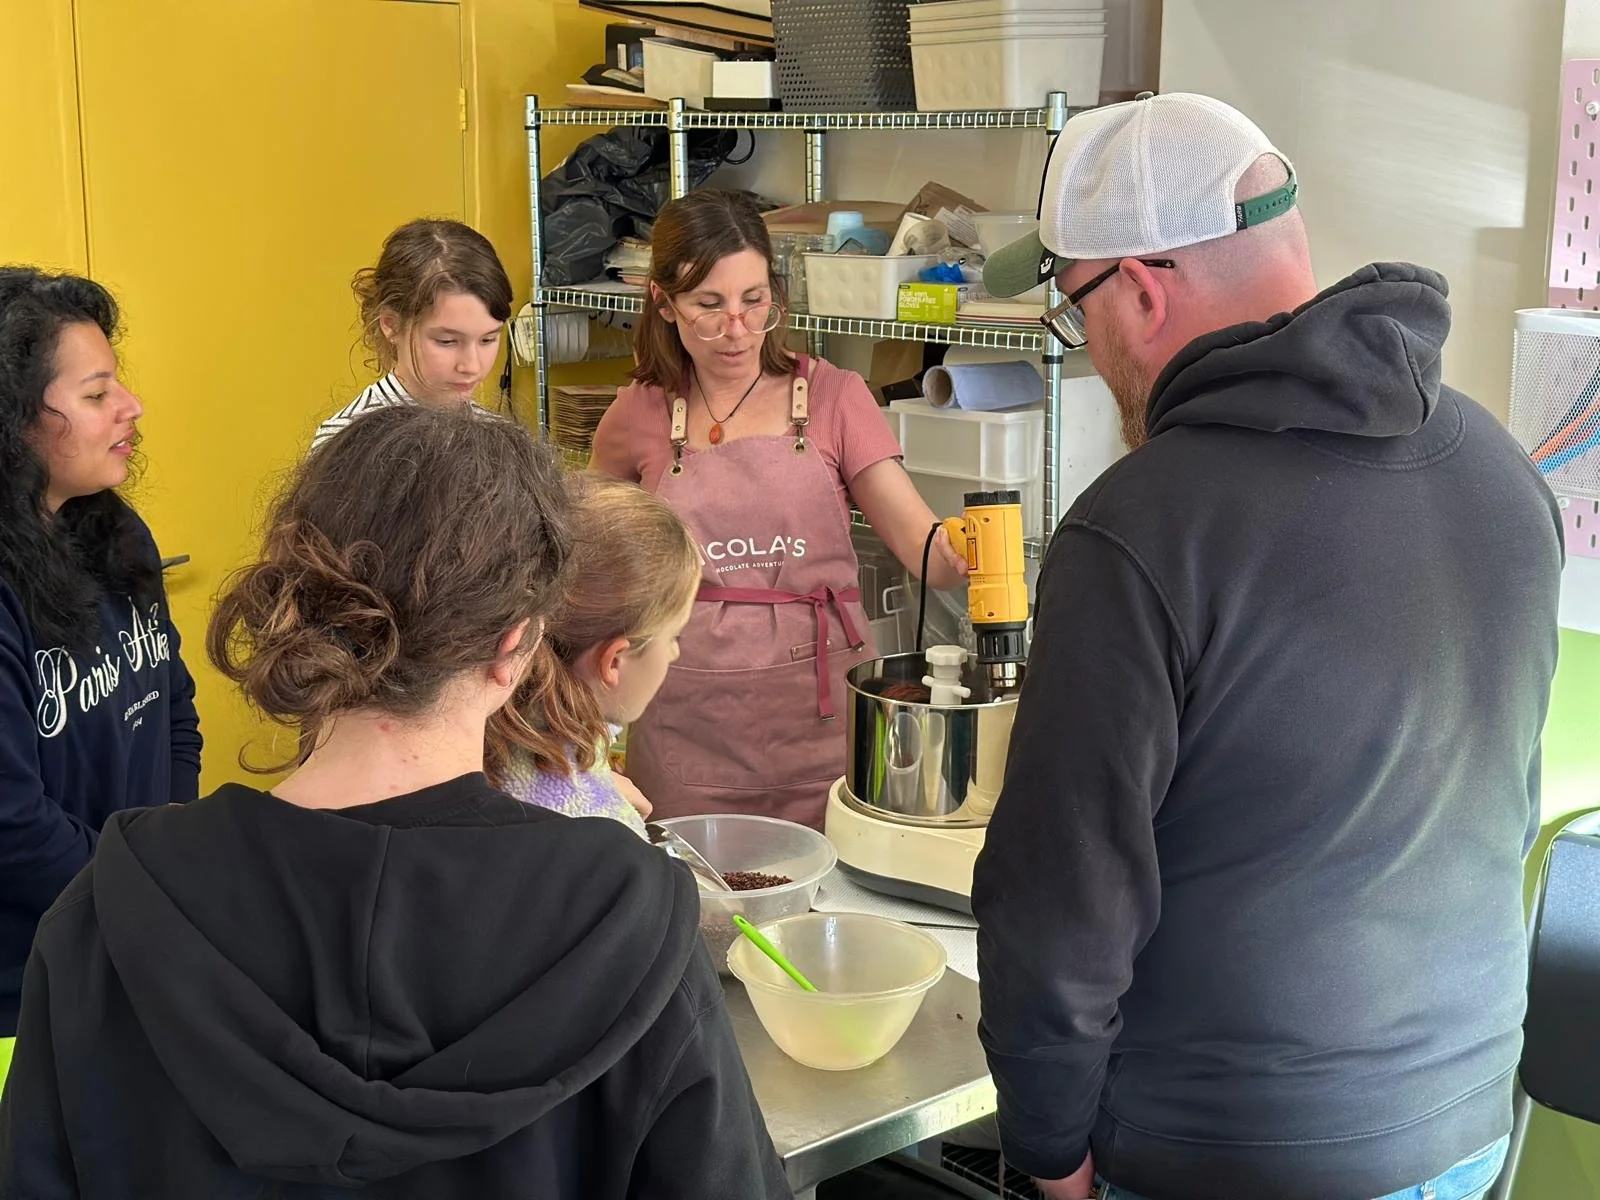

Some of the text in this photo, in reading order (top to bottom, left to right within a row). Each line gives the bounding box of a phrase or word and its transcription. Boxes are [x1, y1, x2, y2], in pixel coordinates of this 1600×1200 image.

[700, 535, 806, 566] COLA'S
[715, 560, 785, 573] HOCOLATE ADVENTU
[35, 646, 121, 738] Paris
